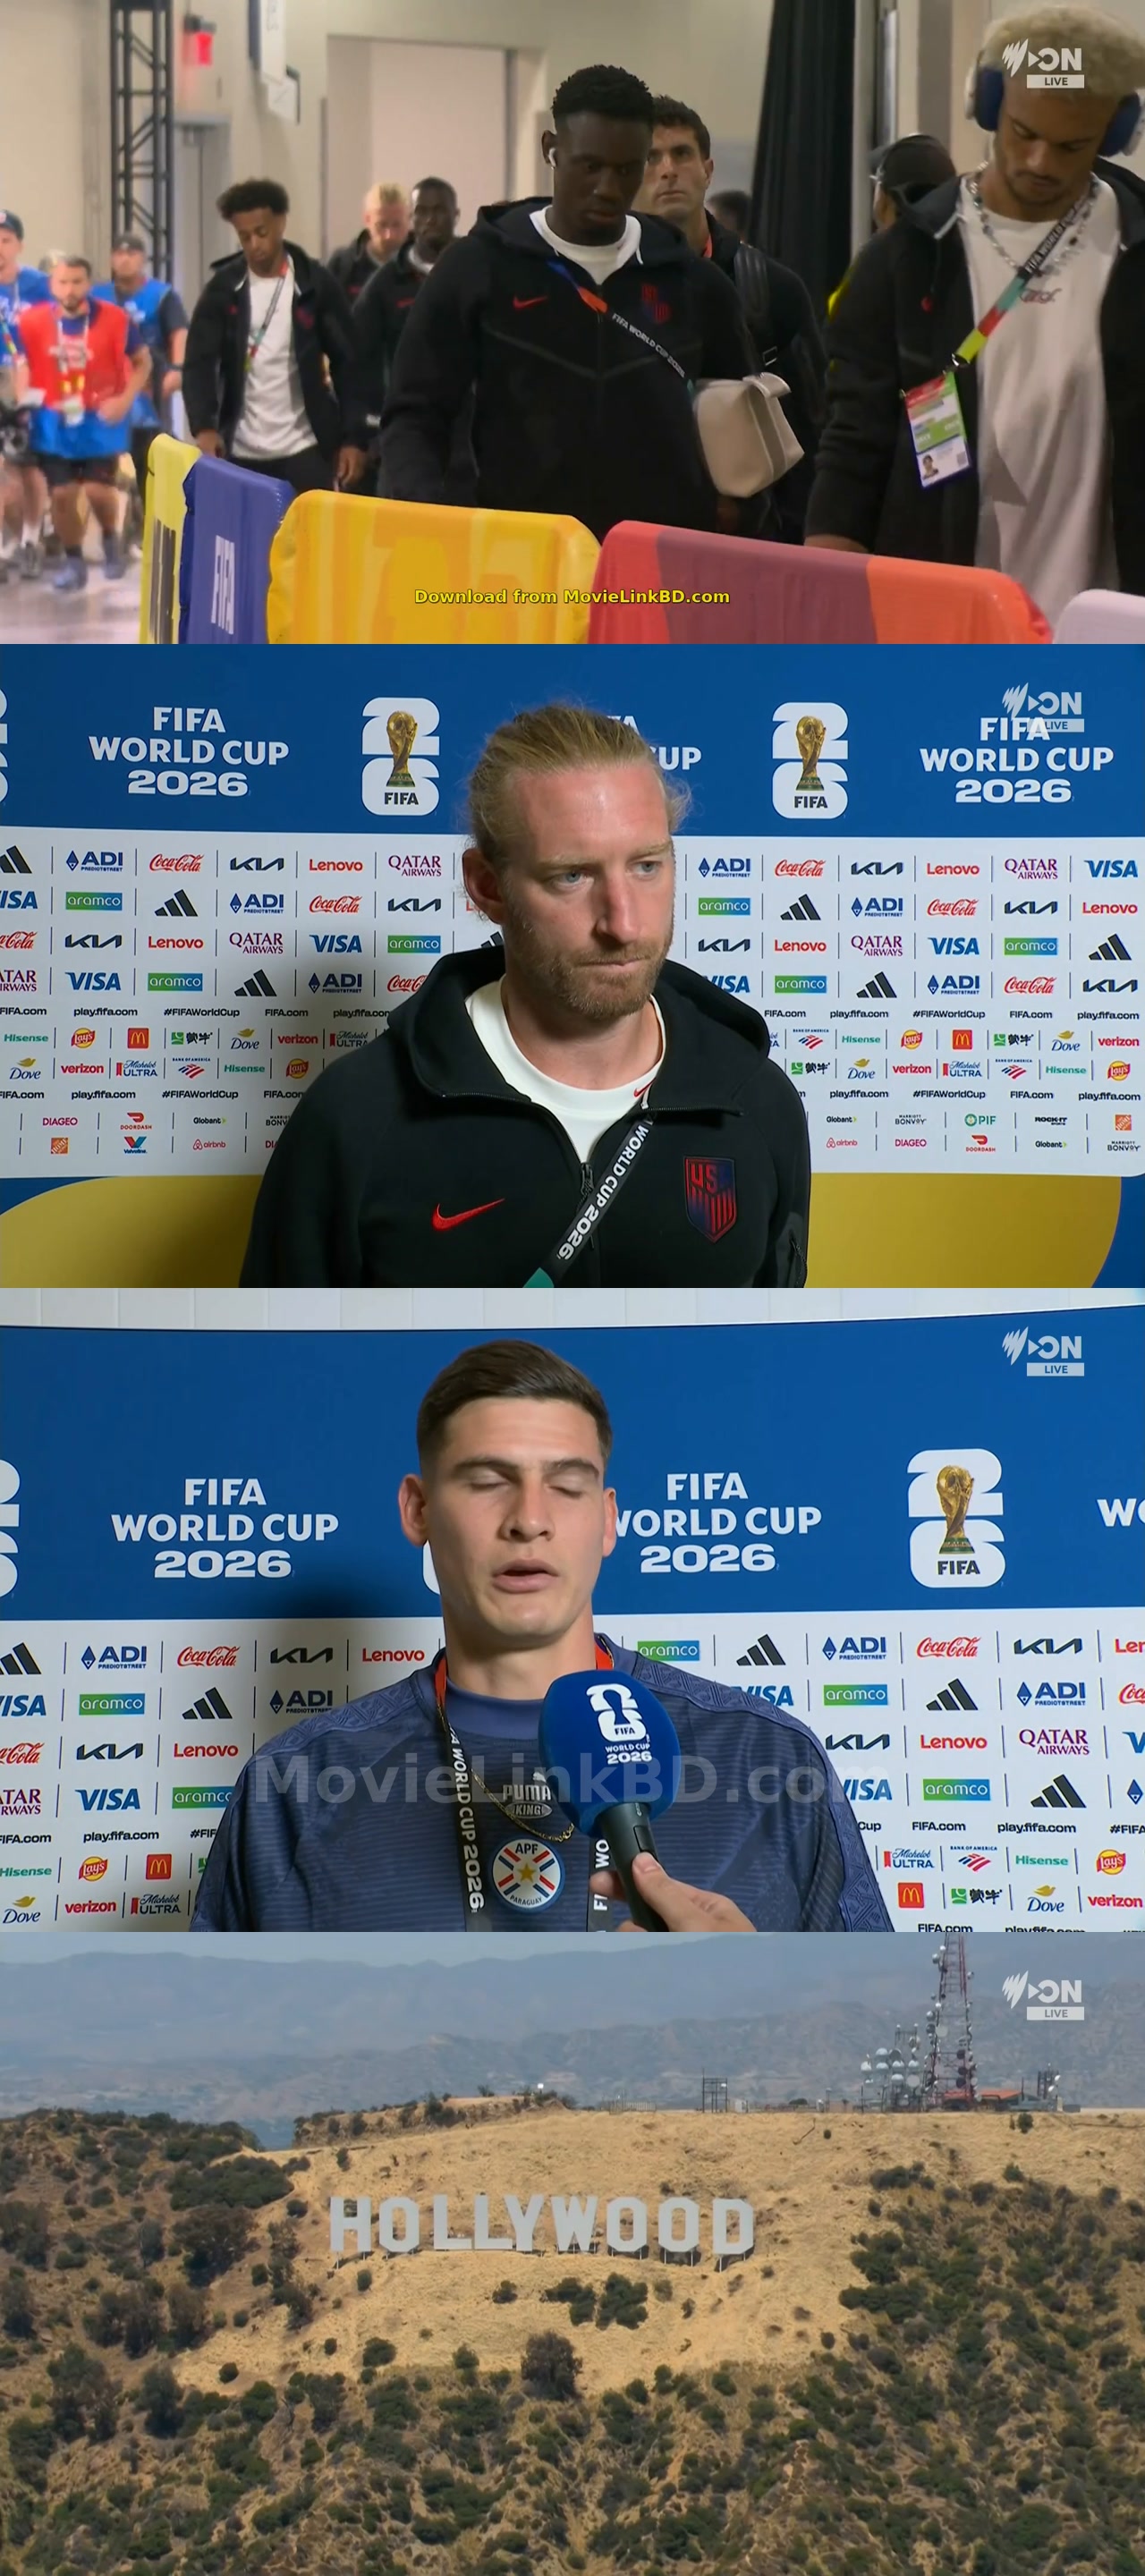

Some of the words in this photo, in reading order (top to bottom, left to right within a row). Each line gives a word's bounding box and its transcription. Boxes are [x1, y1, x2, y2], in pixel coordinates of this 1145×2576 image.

[612, 313, 629, 329] FIFA
[629, 324, 656, 347] WORLD
[154, 707, 225, 733] FIFA
[980, 716, 1051, 741] FIFA
[89, 736, 215, 763] WORLD
[222, 741, 289, 766] CUP
[649, 746, 702, 771] UP
[919, 748, 1039, 773] WORLD
[1046, 747, 1115, 772] CUP
[128, 770, 248, 797] 2026
[955, 778, 1073, 804] 2026
[384, 792, 420, 806] FIFA
[794, 796, 827, 809] FIFA
[81, 852, 123, 866] ADI
[310, 859, 363, 871] Lenovo
[388, 855, 442, 869] QATAR
[927, 862, 980, 876] Lenovo
[1005, 859, 1057, 873] QATAR
[1083, 860, 1138, 877] VISA
[402, 869, 442, 877] AIRWAYS
[1018, 872, 1058, 880] AIRWAYS
[67, 896, 121, 906] aramco
[700, 901, 749, 911] aramco
[1082, 902, 1138, 914] Lenovo
[148, 936, 204, 949] Lenovo
[229, 932, 283, 947] QATAR
[310, 935, 362, 953] VISA
[389, 939, 439, 950] aramco
[242, 946, 283, 954] AIRWAYS
[65, 971, 121, 990] VISA
[776, 979, 825, 988] aramco
[941, 975, 980, 989] ADI
[0, 1007, 47, 1015] FIFA.com
[73, 1007, 138, 1017] play.fifa.com
[164, 1008, 240, 1018] #FIFAWorldCup
[265, 1009, 309, 1017] FIFA.com
[830, 1010, 889, 1019] play.fifa.com
[912, 1010, 986, 1019] #FIFAWorldCup
[1009, 1011, 1053, 1019] FIFA.com
[1077, 1011, 1140, 1021] play.fifa.com
[4, 1034, 48, 1042] Hisense
[231, 1038, 259, 1050] Dove
[277, 1034, 318, 1045] verizon
[1098, 1037, 1140, 1046] verizon
[1051, 1039, 1081, 1052] Dove
[9, 1067, 41, 1080] Dove
[61, 1063, 104, 1073] verizon
[123, 1069, 157, 1077] ULTRA
[224, 1064, 265, 1072] Hisense
[847, 1067, 876, 1080] Dove
[893, 1064, 932, 1074] verizon
[949, 1069, 982, 1077] ULTRA
[1046, 1066, 1087, 1074] Hisense
[72, 1090, 136, 1100] play.fifa.com
[912, 1090, 986, 1099] #FIFAWorldCup
[1010, 1091, 1054, 1099] FIFA.com
[1078, 1092, 1141, 1101] play.fifa.com
[43, 1118, 78, 1126] DIAGEO
[979, 1116, 997, 1125] PIF
[613, 1125, 649, 1177] WORLD
[597, 1175, 618, 1208] CUP
[559, 1204, 599, 1260] 2026
[184, 1479, 267, 1505] FIFA
[666, 1472, 749, 1501] FIFA
[744, 1506, 822, 1535] CUP
[111, 1513, 254, 1542] WORLD
[262, 1513, 338, 1541] CUP
[154, 1550, 293, 1579] 2026
[640, 1543, 776, 1573] 2026
[937, 1560, 981, 1576] FIFA
[639, 1644, 698, 1656] aramco
[839, 1637, 886, 1653] ADI
[98, 1646, 148, 1662] ADI
[362, 1648, 425, 1662] Lenovo
[826, 1689, 886, 1699] aramco
[1035, 1682, 1086, 1699] ADI
[615, 1727, 635, 1735] FIFA
[1019, 1729, 1088, 1745] QATAR
[606, 1743, 634, 1753] WORLD
[635, 1742, 650, 1750] CUP
[920, 1734, 988, 1750] Lenovo
[174, 1743, 238, 1758] Lenovo
[1037, 1745, 1090, 1755] AIRWAYS
[606, 1750, 652, 1765] 2026
[451, 1747, 471, 1804] WORLD
[503, 1784, 551, 1801] PUMA
[925, 1783, 988, 1796] aramco
[75, 1789, 140, 1810] VISA
[515, 1805, 541, 1815] KING
[459, 1807, 476, 1841] CUP
[912, 1822, 966, 1832] FIFA.com
[997, 1823, 1076, 1834] play.fifa.com
[83, 1831, 159, 1843] play.fifa.com
[515, 1843, 539, 1855] APF
[892, 1860, 935, 1868] ULTRA
[1015, 1855, 1068, 1866] Hisense
[0, 1867, 52, 1877] Hisense
[463, 1844, 485, 1909] 2026
[509, 1894, 543, 1906] PARAGUAY
[1027, 1896, 1064, 1912] Dove
[1088, 1894, 1143, 1908] verizon
[65, 1901, 116, 1913] verizon
[140, 1904, 181, 1915] ULTRA
[3, 1909, 41, 1924] Dove
[329, 2194, 754, 2254] HOLLYWOOD
